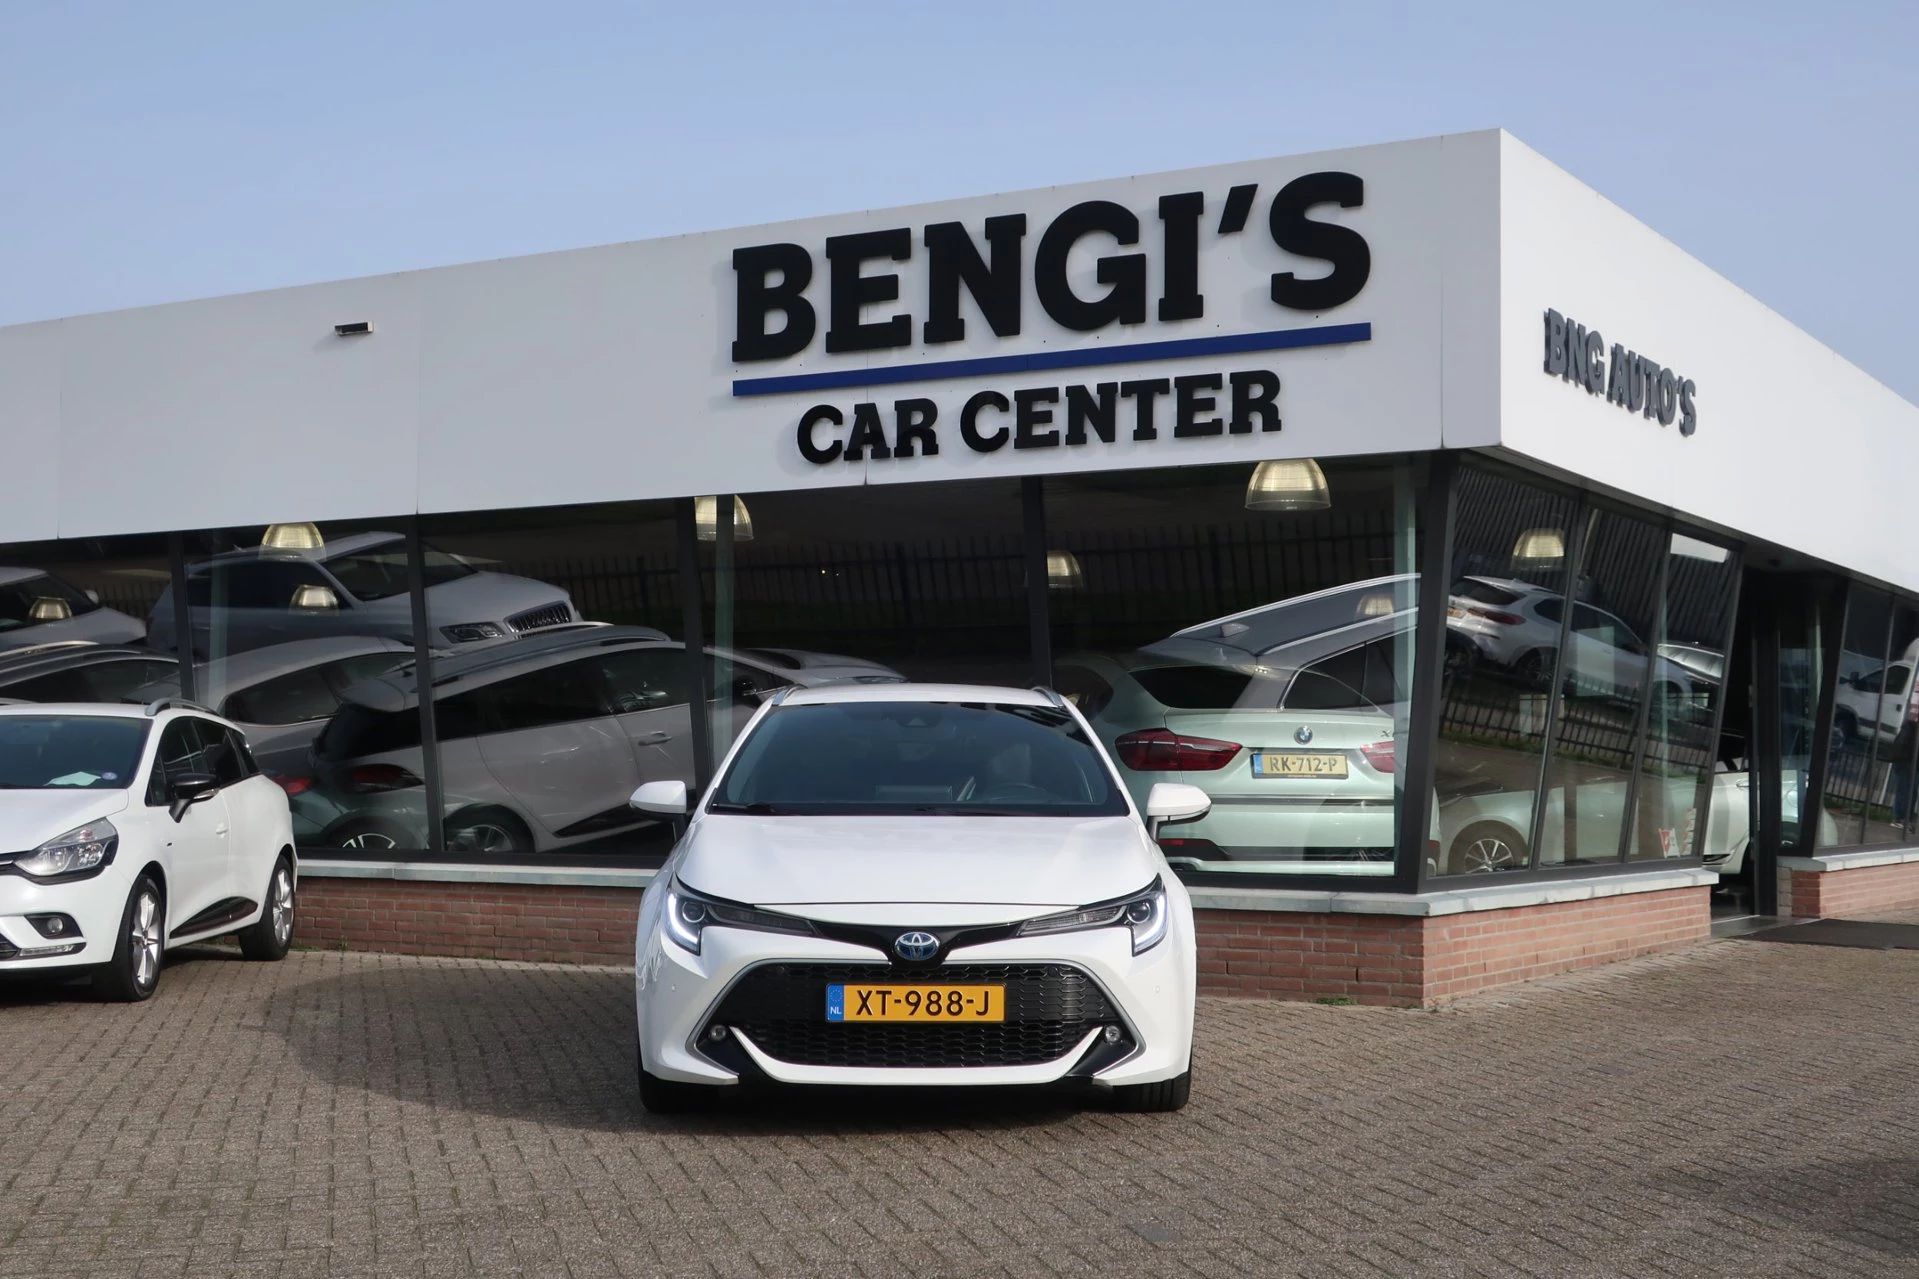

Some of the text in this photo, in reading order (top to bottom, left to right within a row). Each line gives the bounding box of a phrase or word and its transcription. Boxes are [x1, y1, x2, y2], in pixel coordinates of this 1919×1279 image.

[732, 171, 1371, 362] BENGI'S
[1543, 307, 1697, 437] BNG AUTO'S
[797, 369, 1281, 464] CAR CENTER
[1269, 756, 1338, 772] RK-712-P
[830, 1006, 842, 1015] NL
[856, 990, 989, 1016] XT-988-J
